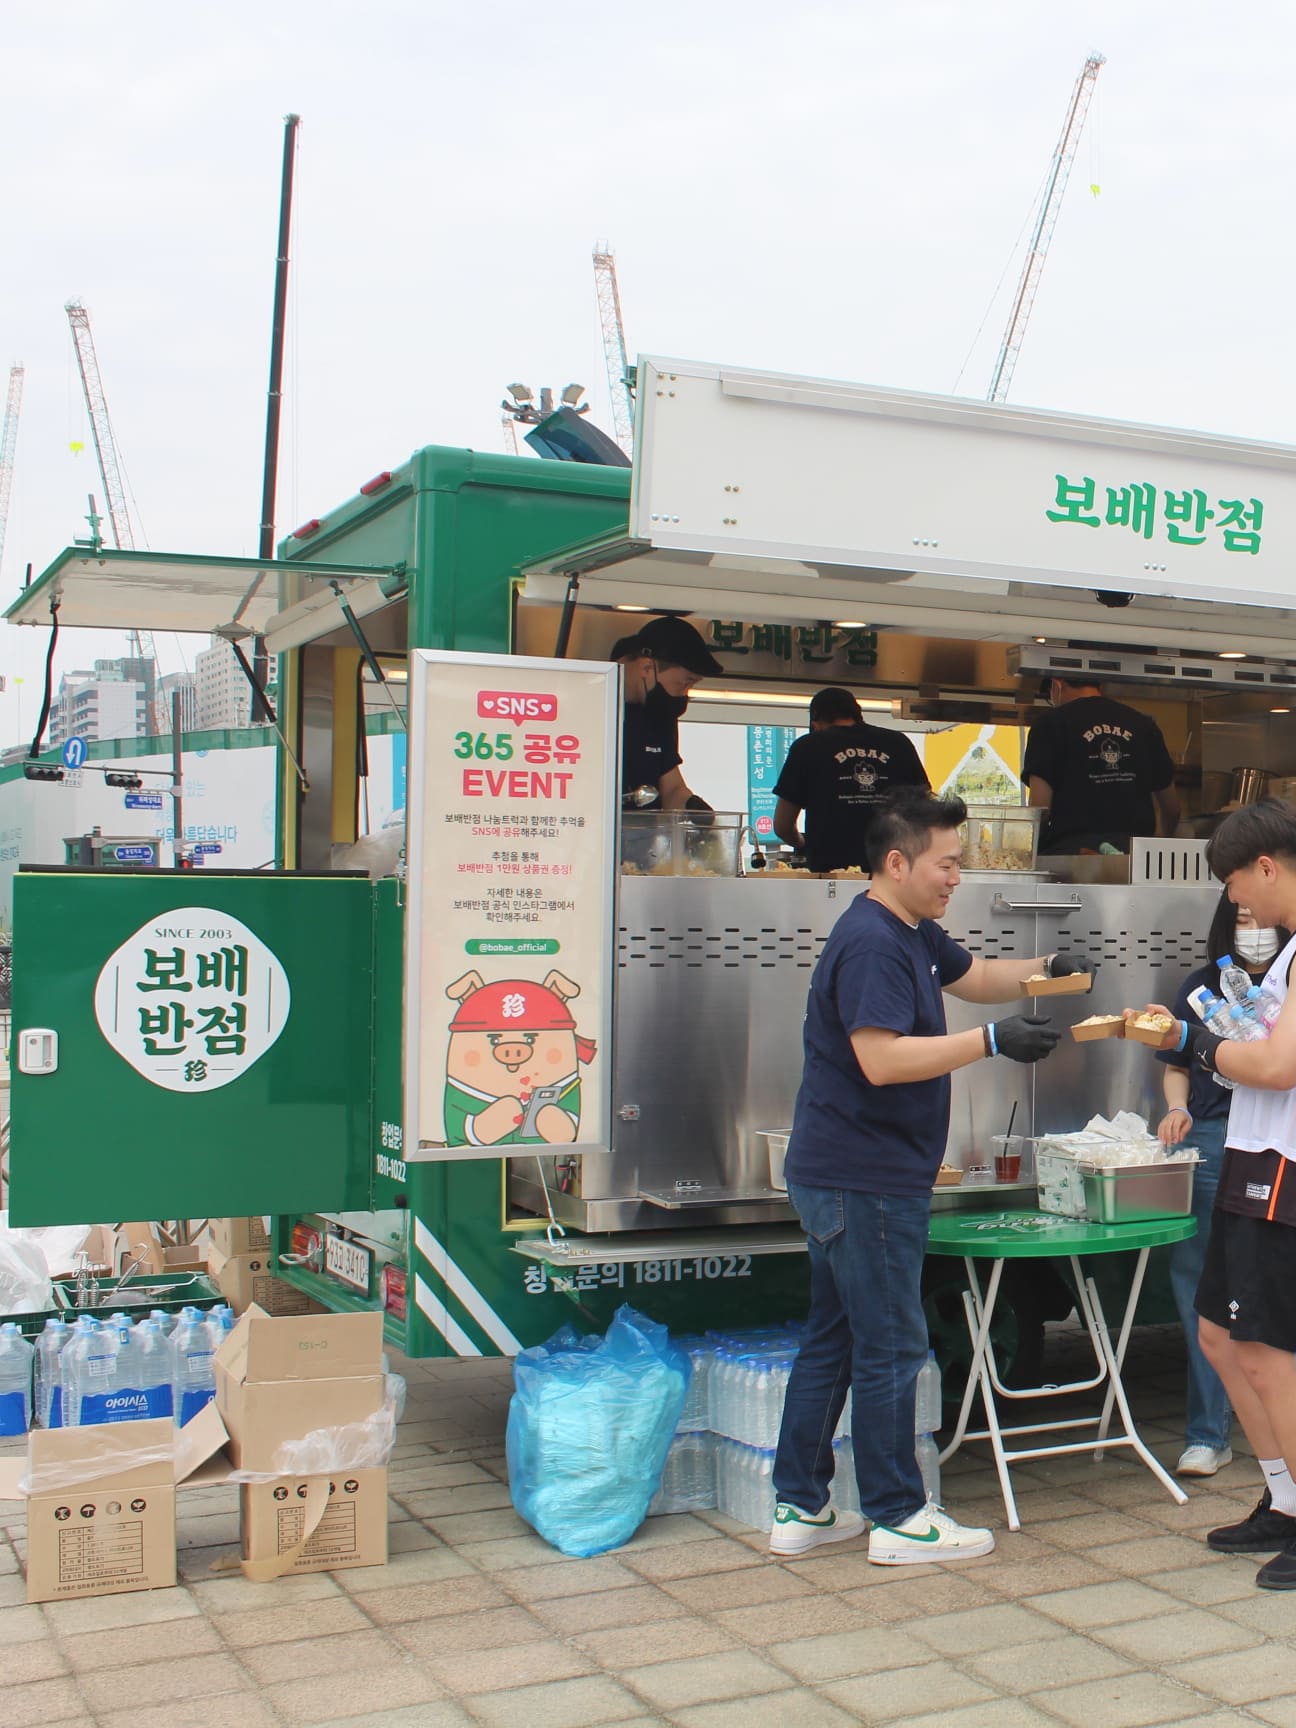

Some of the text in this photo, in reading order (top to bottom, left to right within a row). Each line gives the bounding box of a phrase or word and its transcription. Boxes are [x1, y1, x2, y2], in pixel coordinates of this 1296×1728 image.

[1045, 474, 1264, 555] 보배반점
[705, 619, 878, 666] 보배반점
[497, 697, 539, 716] SNS
[1083, 724, 1133, 742] BOBAE
[454, 731, 582, 765] 365 공유
[834, 748, 890, 764] BOBAE
[463, 769, 573, 799] EVENT
[445, 814, 585, 828] 보배반점 나눔트럭과 함께한 추억을
[472, 827, 559, 838] SNS에 공유해주세요!
[492, 851, 539, 862] 추첨을 통해
[457, 863, 572, 875] 보배반점 1만원 상품권 증정!
[487, 888, 543, 899] 자세한 내용은
[453, 900, 575, 912] 보배반점 공식 인스타그램에서
[155, 928, 233, 939] SINCE 2003
[479, 943, 547, 953] @bobae_official
[136, 944, 249, 997] 보배
[137, 1001, 247, 1056] 반점
[377, 1153, 406, 1183] 1811-1022
[633, 1254, 752, 1284] 1811-1022
[105, 1394, 147, 1408] 아이시스
